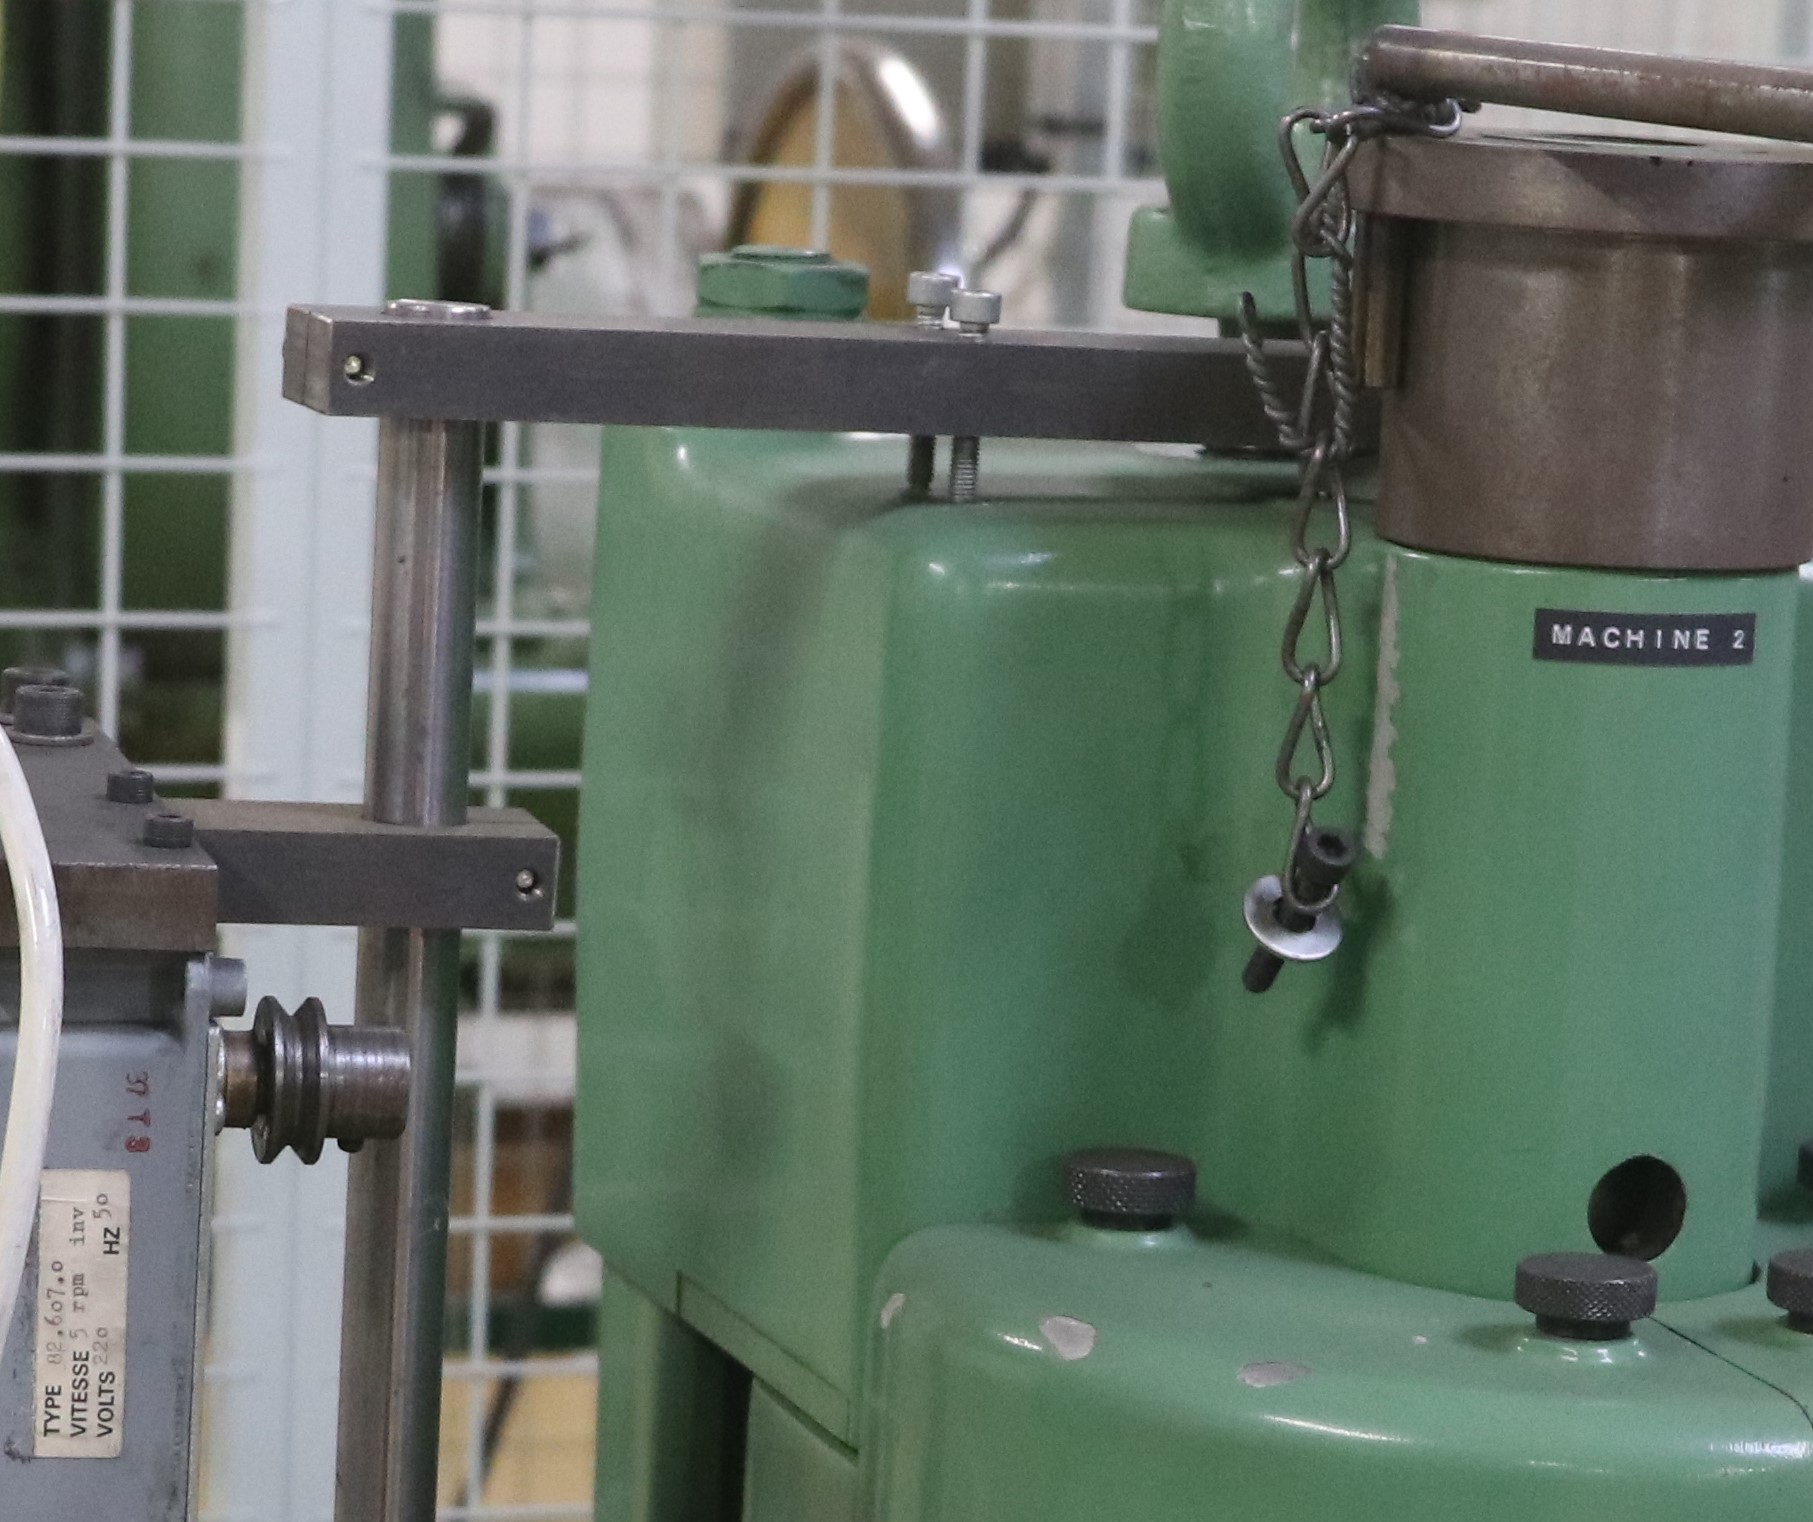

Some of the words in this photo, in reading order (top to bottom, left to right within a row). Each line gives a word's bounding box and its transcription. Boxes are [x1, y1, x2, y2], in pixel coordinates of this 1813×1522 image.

[1551, 624, 1710, 650] MACHINE
[1732, 629, 1746, 650] 2
[92, 1194, 112, 1220] 50
[69, 1207, 85, 1246] inv
[104, 1227, 120, 1255] HZ
[72, 1273, 88, 1313] rpm
[69, 1329, 87, 1339] 5
[92, 1327, 109, 1365] 220
[43, 1385, 63, 1437] TYPE
[70, 1351, 89, 1438] VITESSE
[97, 1371, 116, 1438] VOLTS
